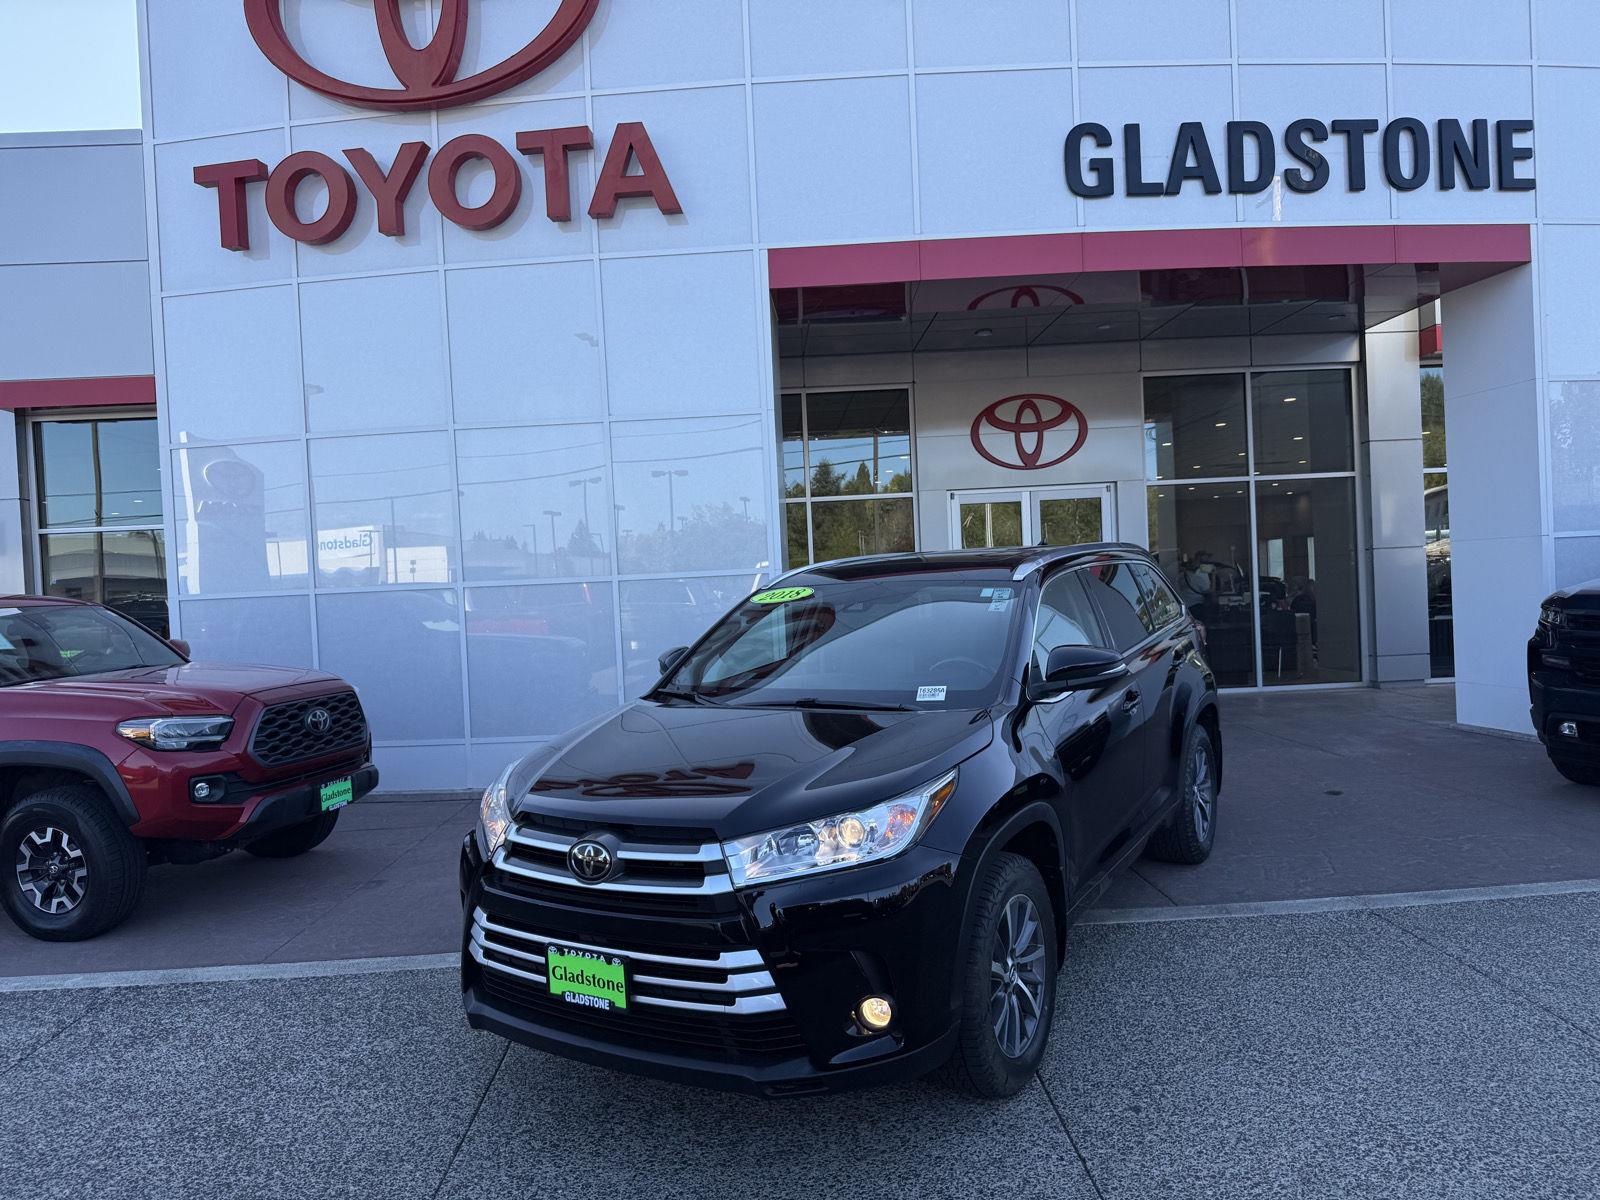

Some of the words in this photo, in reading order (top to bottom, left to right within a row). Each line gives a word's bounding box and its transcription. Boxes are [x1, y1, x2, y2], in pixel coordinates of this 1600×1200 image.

[1064, 117, 1536, 199] GLADSTONE
[193, 121, 684, 252] TOYOTA
[758, 588, 807, 601] 2018
[321, 787, 351, 802] Gladstone
[563, 948, 606, 962] TOYOTA
[551, 965, 624, 993] Gladstone
[564, 991, 610, 1010] GLADSTONE
